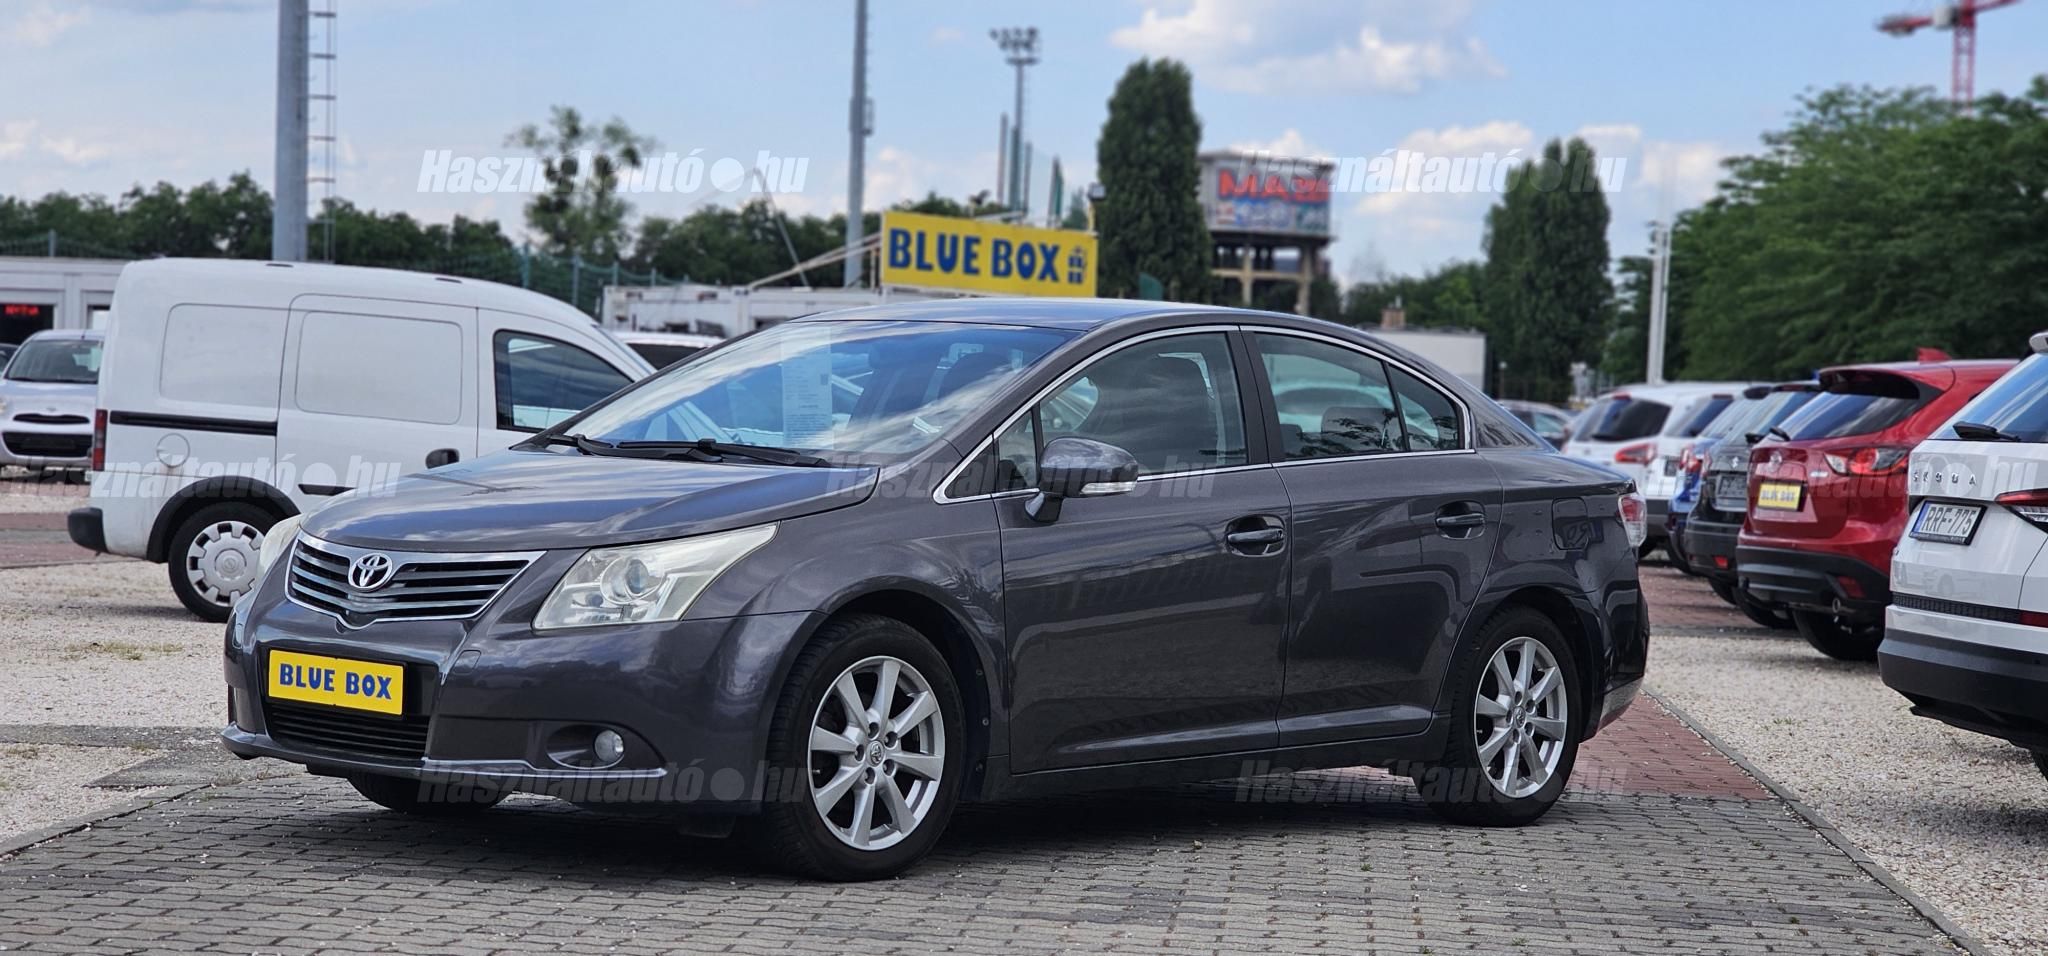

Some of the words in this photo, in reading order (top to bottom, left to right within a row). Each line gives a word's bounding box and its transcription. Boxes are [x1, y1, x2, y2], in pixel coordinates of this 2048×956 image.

[888, 228, 981, 275] BLUE
[990, 237, 1060, 282] BOX
[1921, 506, 1976, 535] RRF-775
[280, 663, 335, 691] BLUE
[345, 671, 392, 700] BOX
